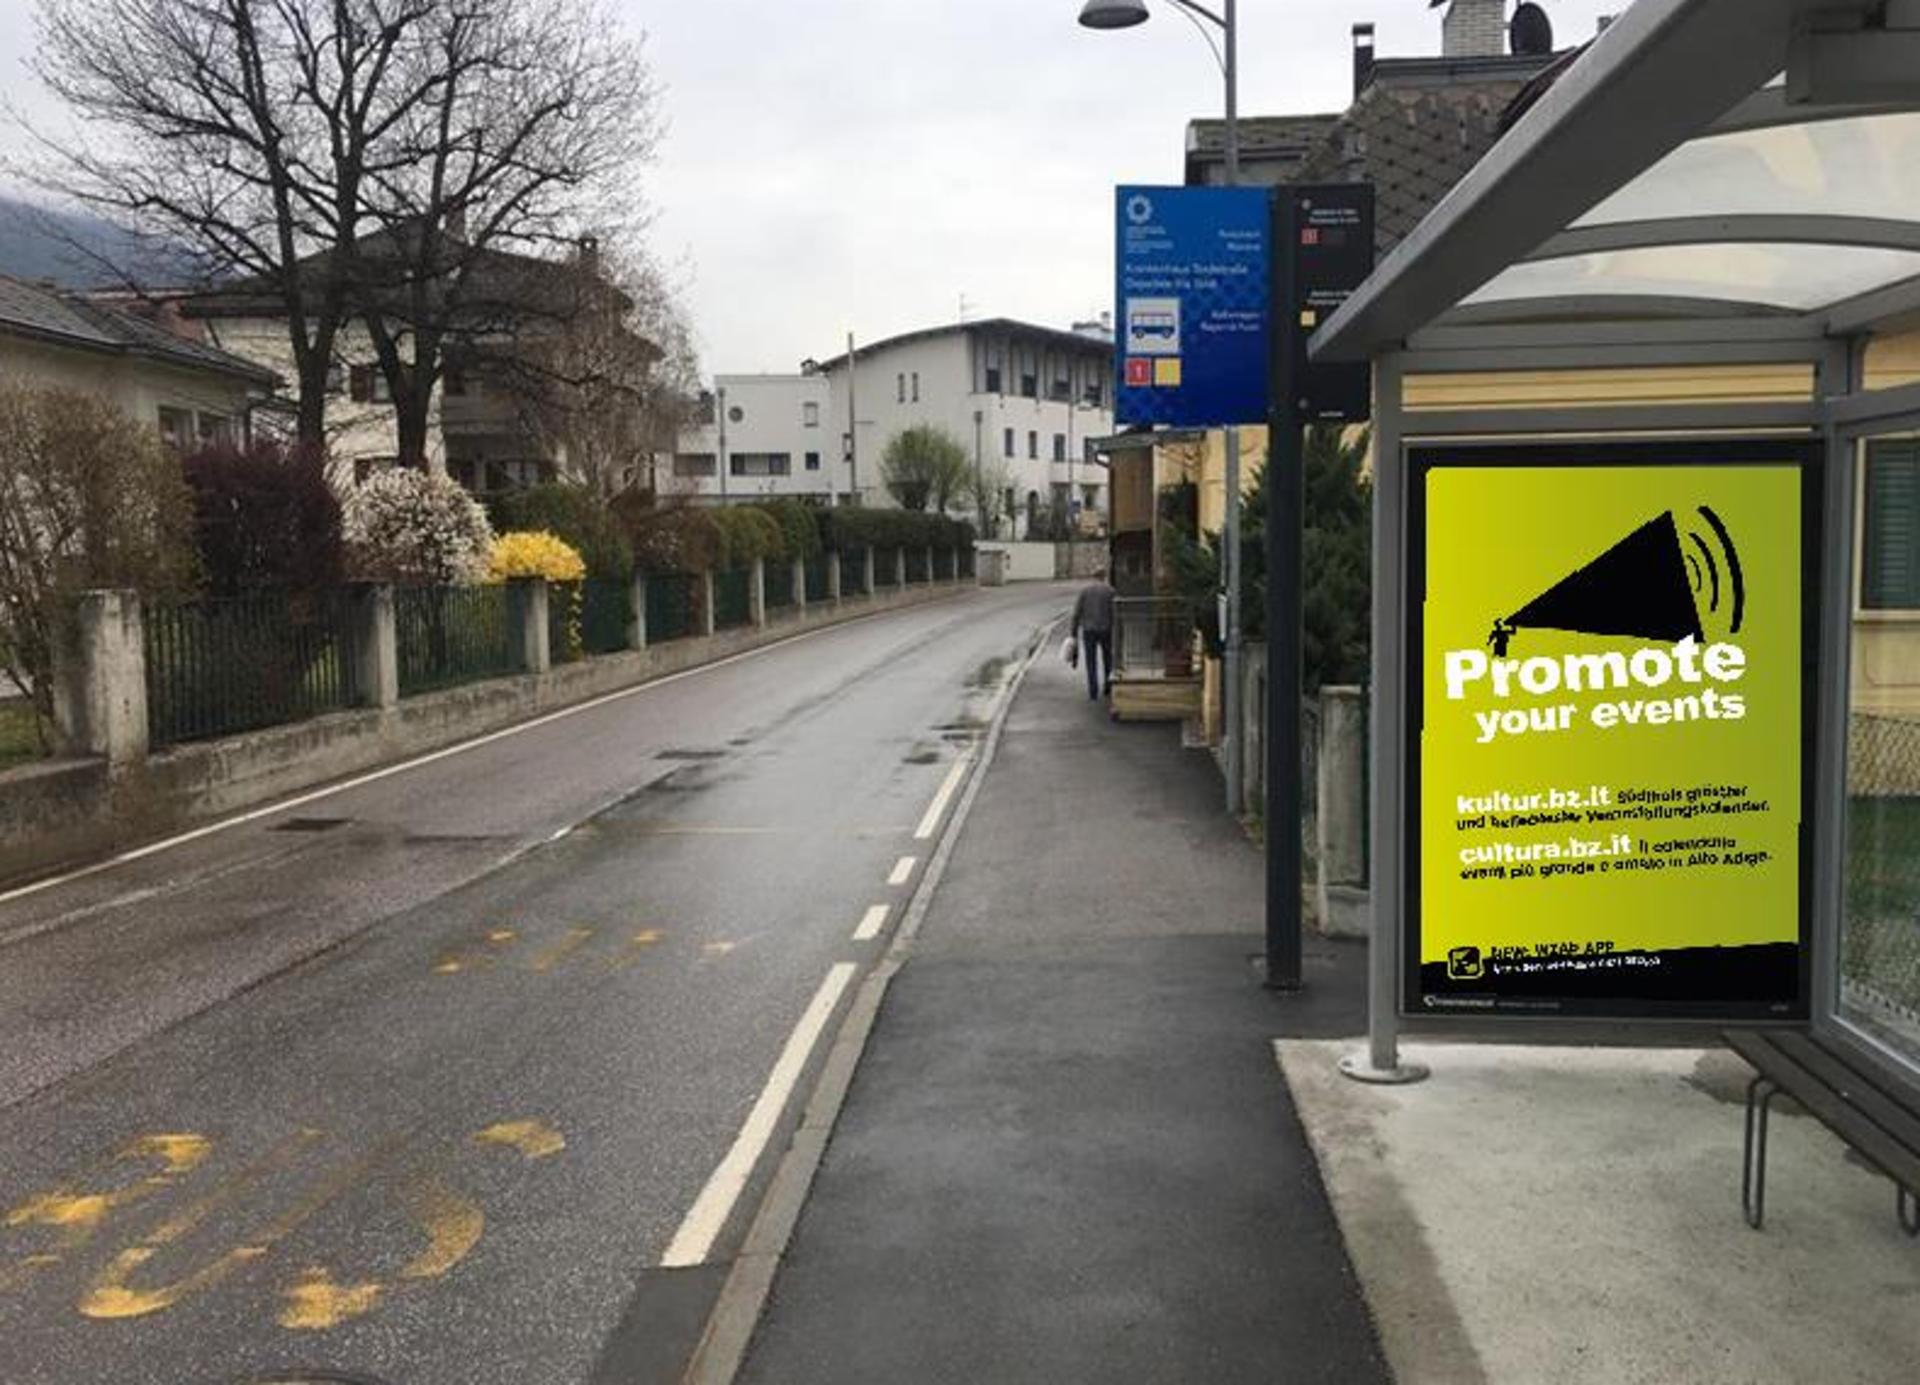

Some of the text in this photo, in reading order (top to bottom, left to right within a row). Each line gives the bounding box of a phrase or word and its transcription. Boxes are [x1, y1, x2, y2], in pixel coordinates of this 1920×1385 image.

[1444, 633, 1746, 699] Promote
[1475, 687, 1746, 743] your events
[1456, 785, 1611, 814] kultur.bz.it
[1459, 833, 1632, 865] cultura.bz.it
